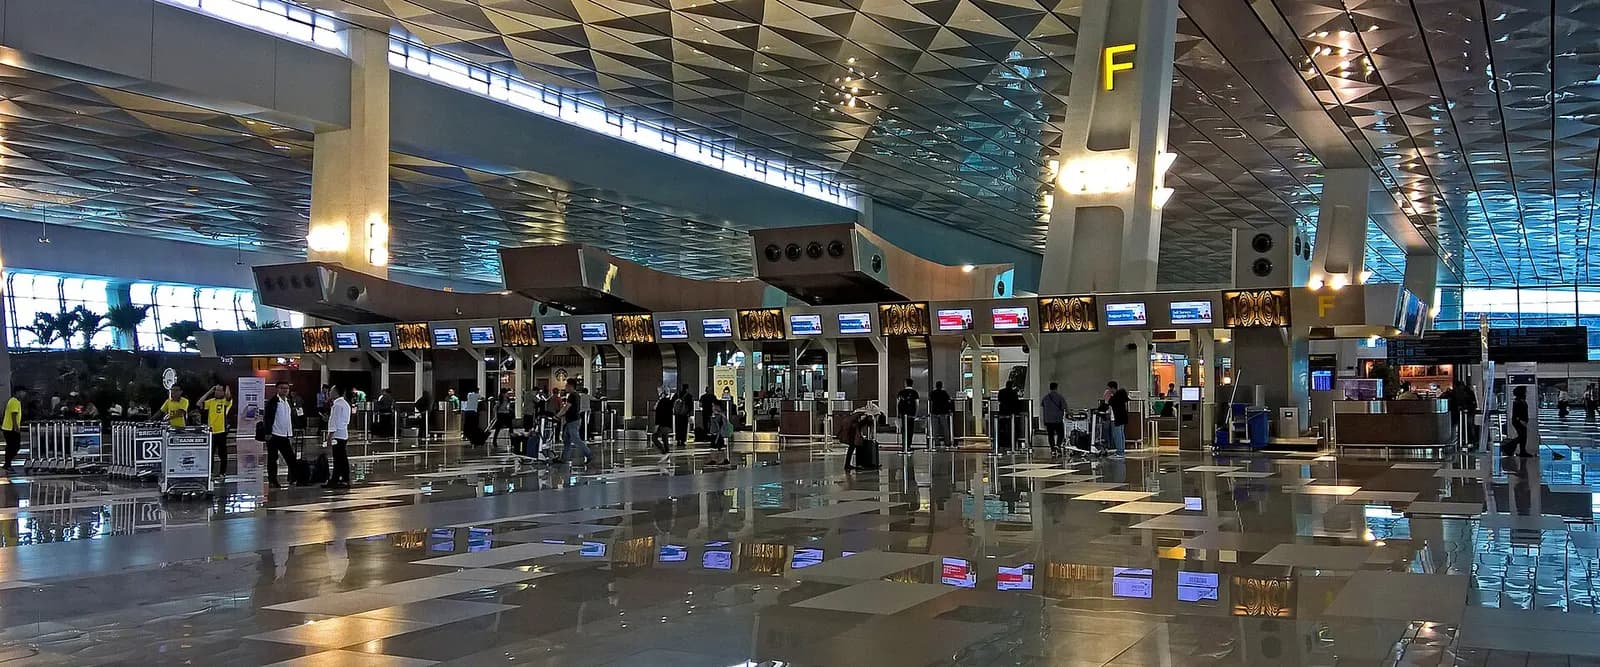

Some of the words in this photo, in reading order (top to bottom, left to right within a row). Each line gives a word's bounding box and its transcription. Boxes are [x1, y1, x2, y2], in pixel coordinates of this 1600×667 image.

[1105, 43, 1136, 90] F
[1318, 295, 1335, 317] F
[1508, 376, 1515, 384] F
